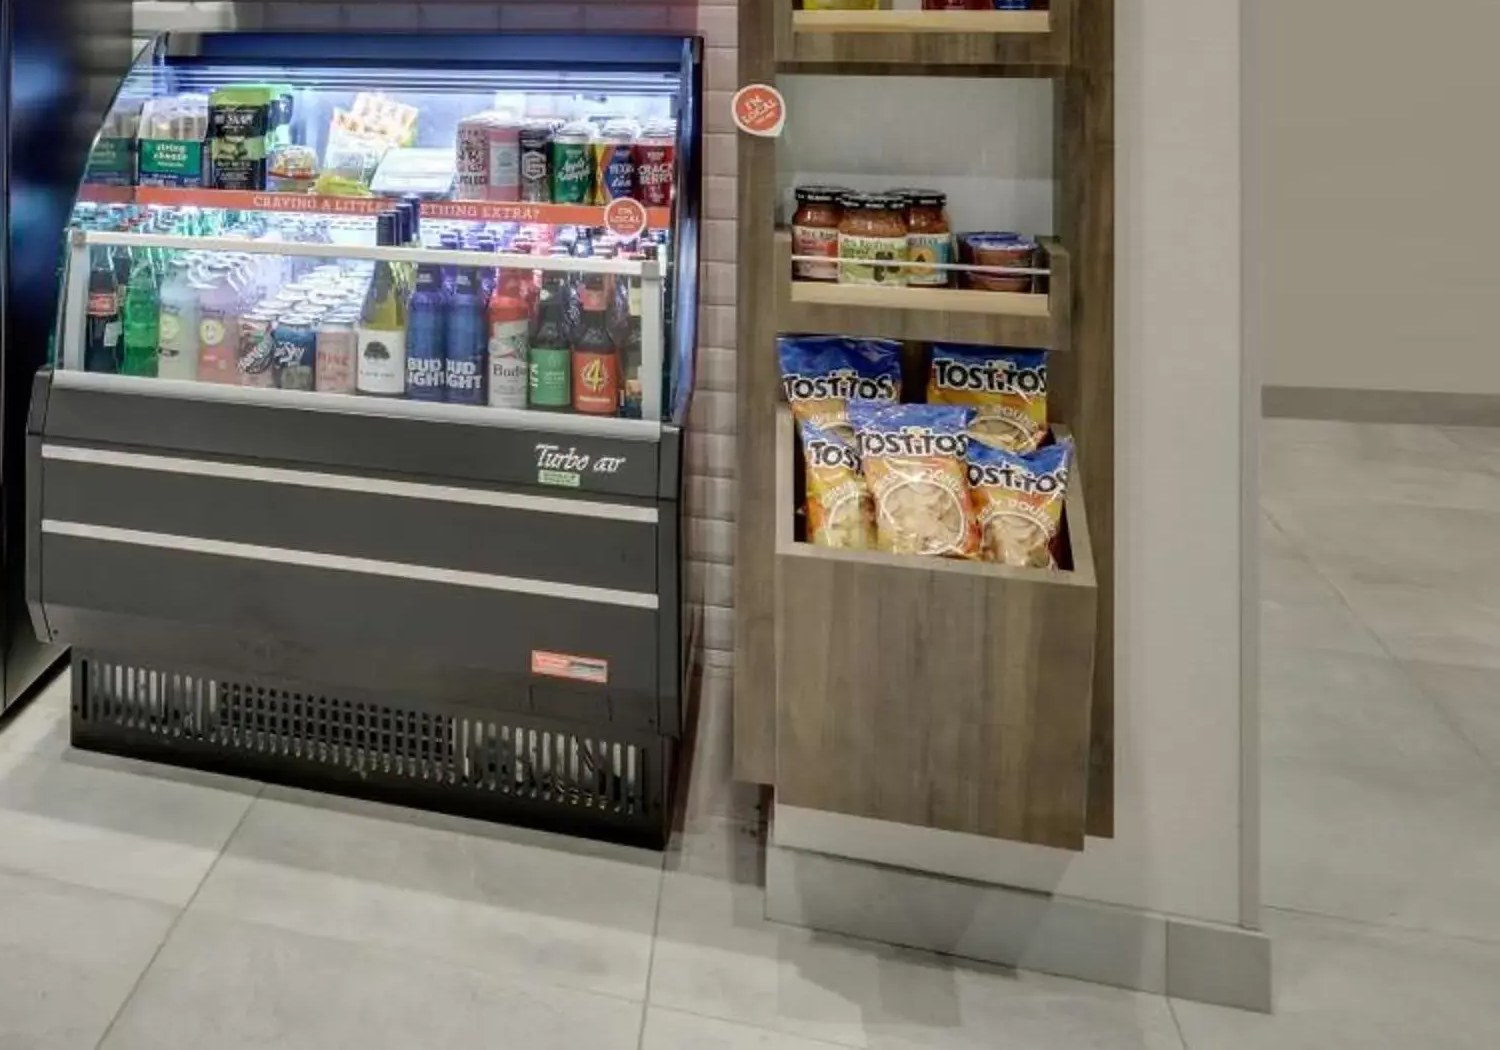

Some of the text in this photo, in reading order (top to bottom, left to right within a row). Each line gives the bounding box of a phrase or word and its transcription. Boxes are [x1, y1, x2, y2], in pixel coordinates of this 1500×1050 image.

[253, 195, 317, 209] CRAVING
[481, 203, 542, 221] EXTRA?
[407, 357, 442, 371] BUD
[535, 443, 590, 472] Turbo
[968, 462, 1069, 495] OSTITOS
